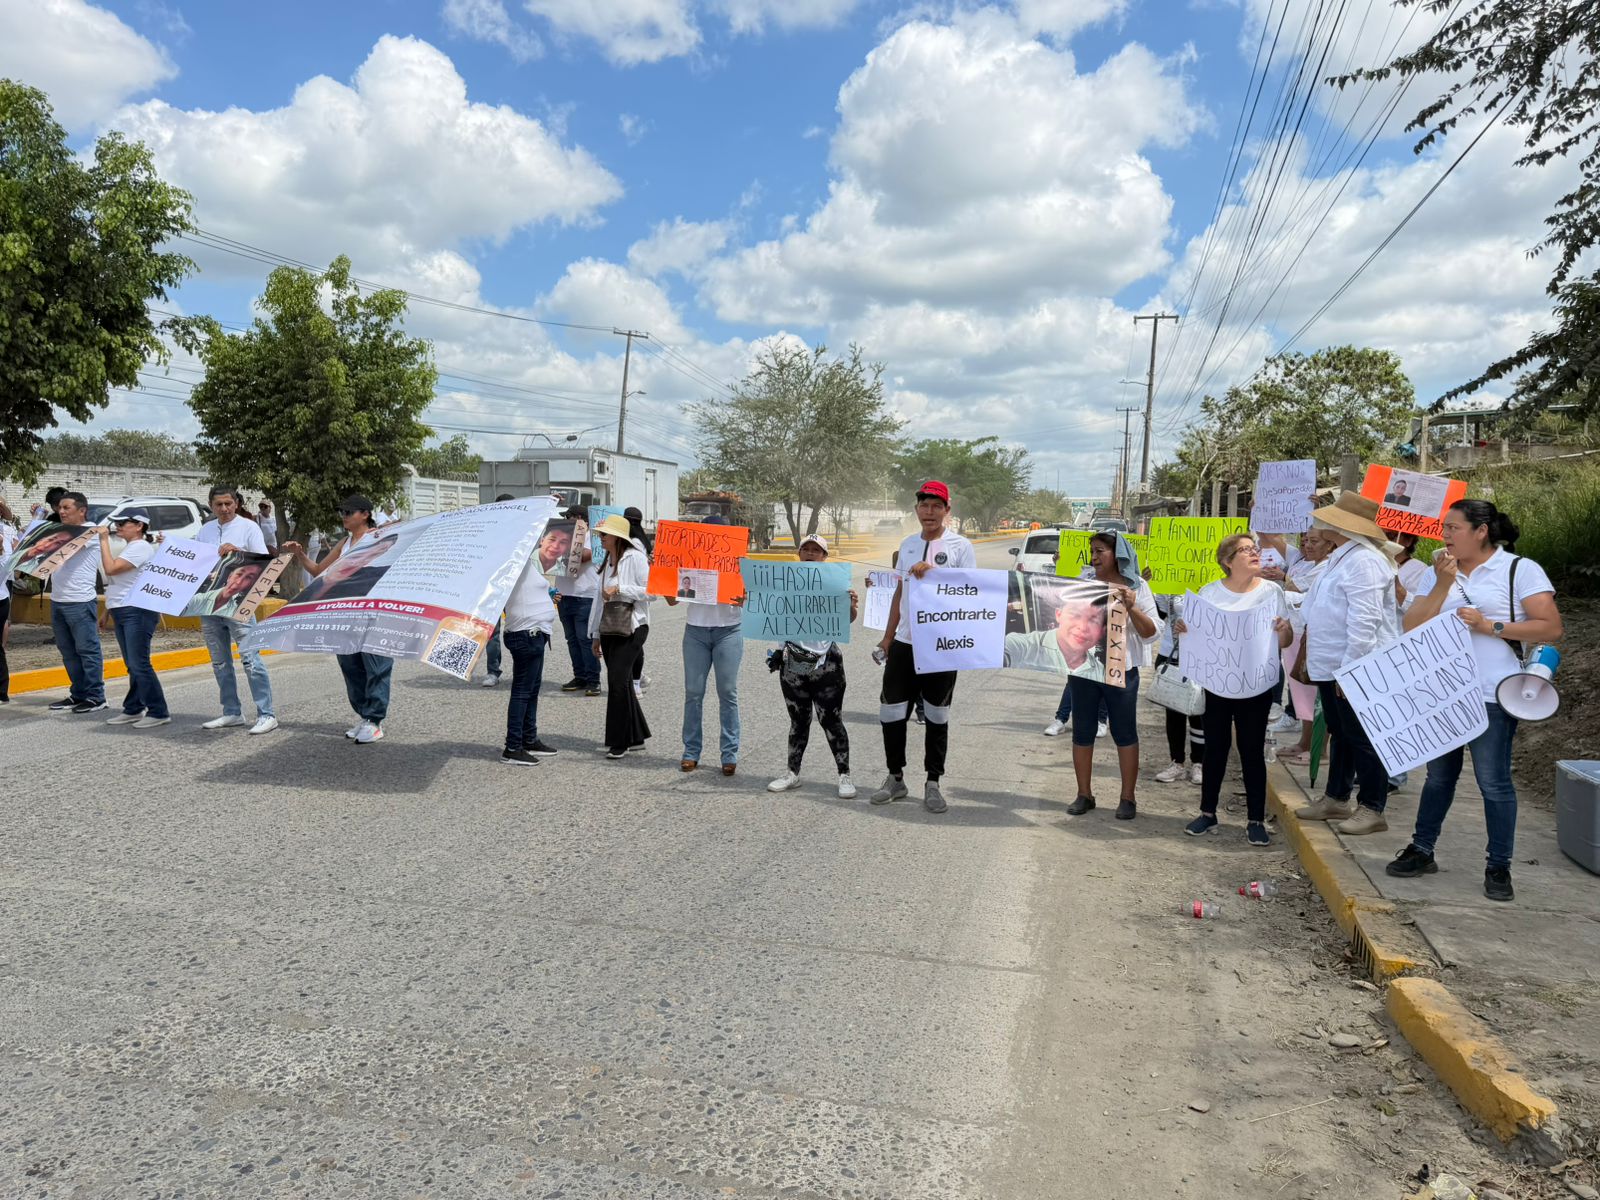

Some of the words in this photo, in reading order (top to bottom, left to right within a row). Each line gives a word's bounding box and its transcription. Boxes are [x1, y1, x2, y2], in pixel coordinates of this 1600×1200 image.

[165, 545, 196, 561] Hasta
[569, 525, 585, 574] ALEXIS
[140, 582, 173, 600] Alexis
[239, 558, 284, 617] ALEXIS
[936, 583, 979, 596] Hasta
[378, 601, 426, 615] VOLVER!
[746, 591, 841, 616] ENCONTRARTE
[762, 616, 842, 637] ALEXIS!!!
[916, 608, 997, 625] Encontrarte
[367, 626, 414, 638] mergencias
[935, 635, 975, 652] Alexis
[1206, 638, 1243, 668] SON
[1341, 659, 1390, 702] TU
[1383, 613, 1468, 684] FAMILIA
[1185, 651, 1277, 695] PERSONAS
[1359, 703, 1395, 738] NO
[1391, 653, 1476, 722] DESCANSA
[1375, 723, 1438, 771] HASTA
